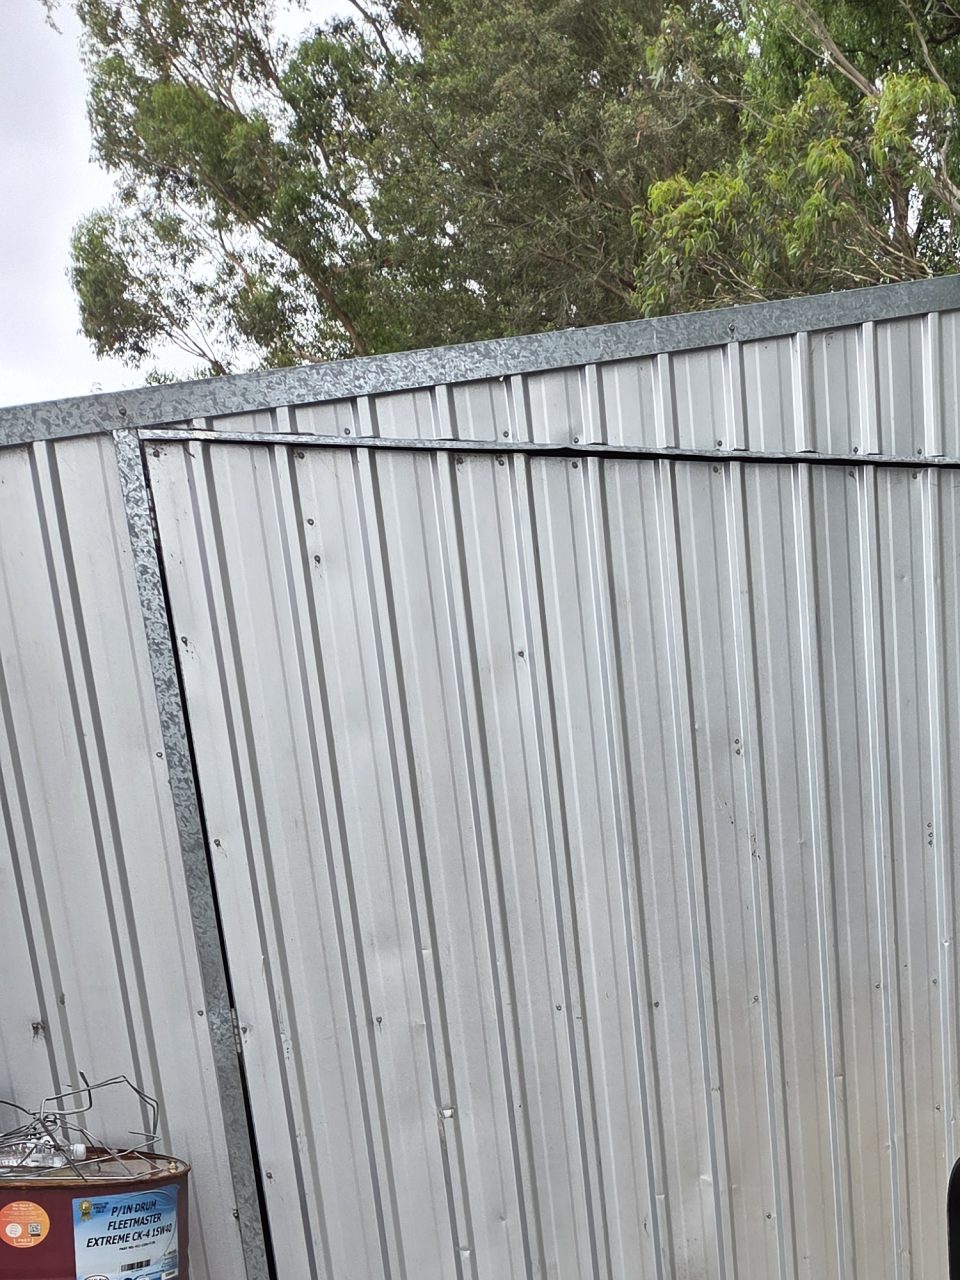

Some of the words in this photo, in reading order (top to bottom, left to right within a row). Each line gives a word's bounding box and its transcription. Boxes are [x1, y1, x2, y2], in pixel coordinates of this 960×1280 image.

[134, 1200, 157, 1212] DRUM
[107, 1213, 162, 1231] FLEETMASTER
[86, 1232, 131, 1248] EXTREME
[132, 1229, 150, 1240] CK-4
[152, 1223, 172, 1238] 15W40
